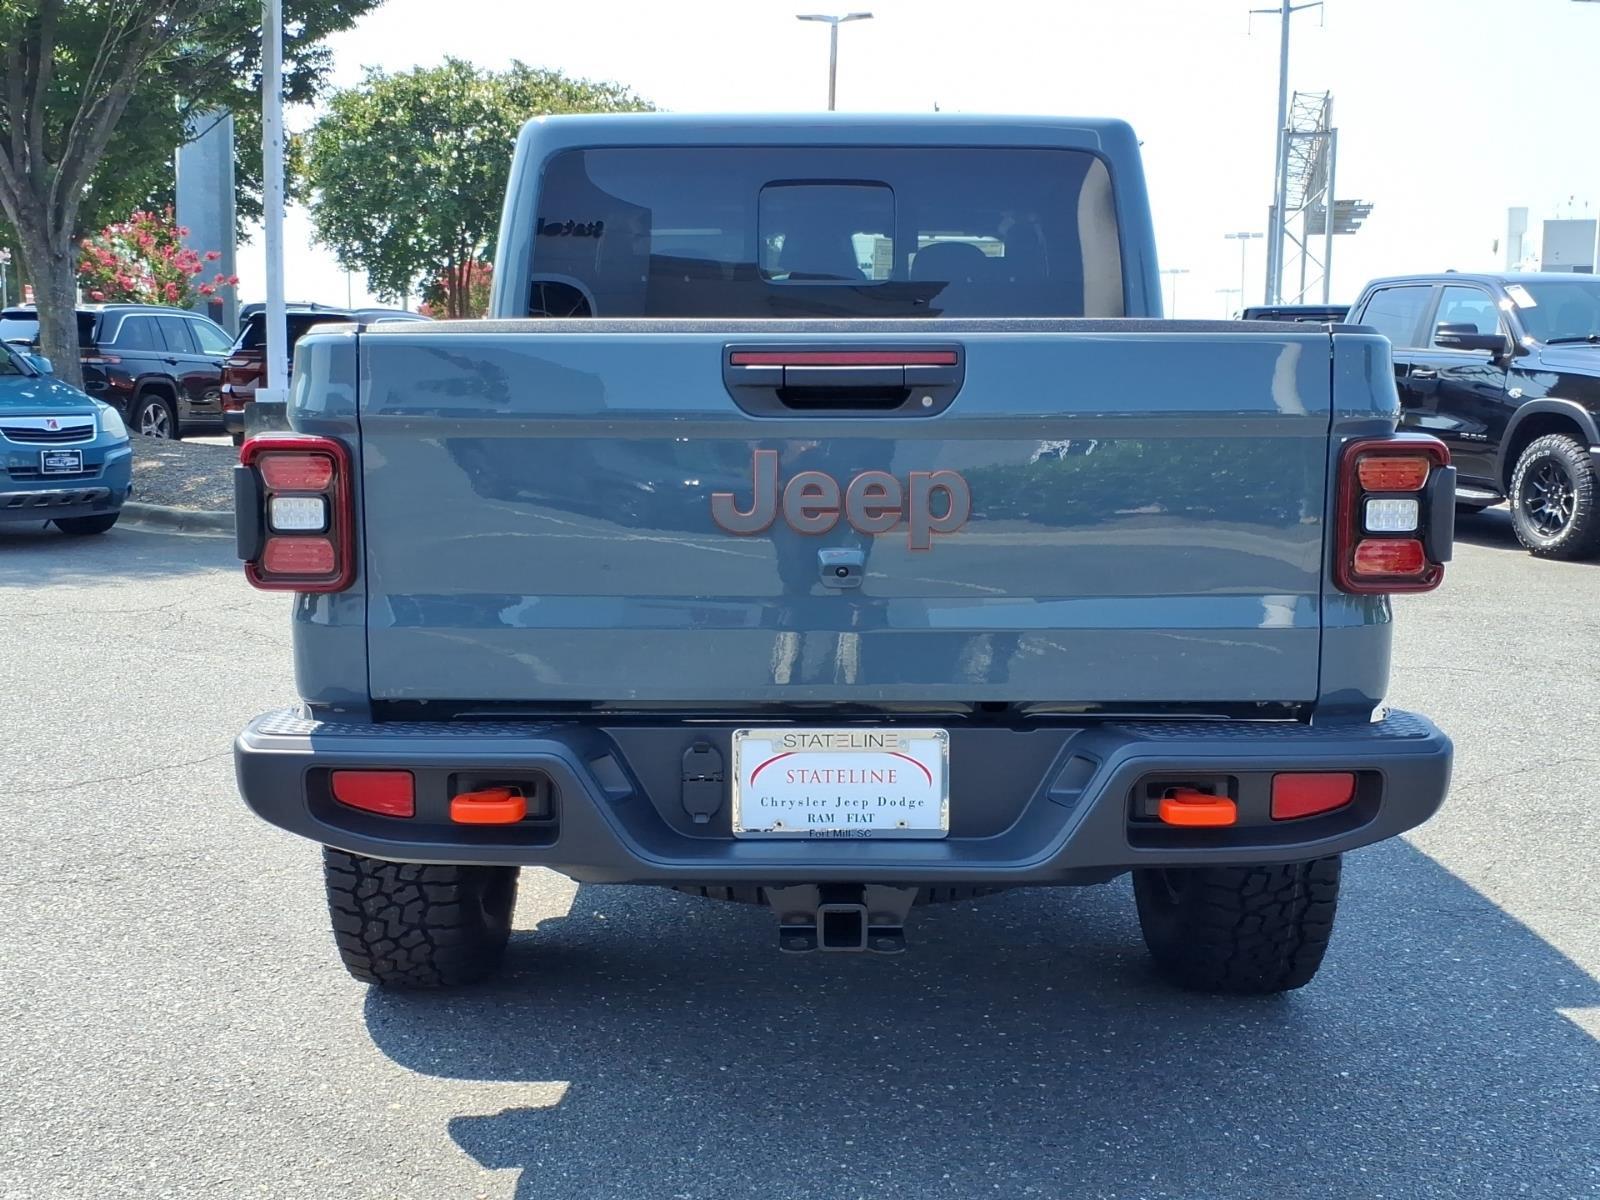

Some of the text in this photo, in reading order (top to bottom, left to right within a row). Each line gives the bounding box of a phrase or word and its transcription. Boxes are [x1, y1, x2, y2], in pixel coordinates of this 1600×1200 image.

[1460, 432, 1488, 441] RAM
[711, 449, 971, 551] Jeep
[783, 733, 898, 748] STATELINE
[786, 769, 897, 784] STATELINE
[760, 797, 925, 810] Chrysler Jeep Dodge
[807, 813, 876, 823] RAM FIAT
[809, 829, 829, 838] Fort
[857, 829, 872, 838] SC
